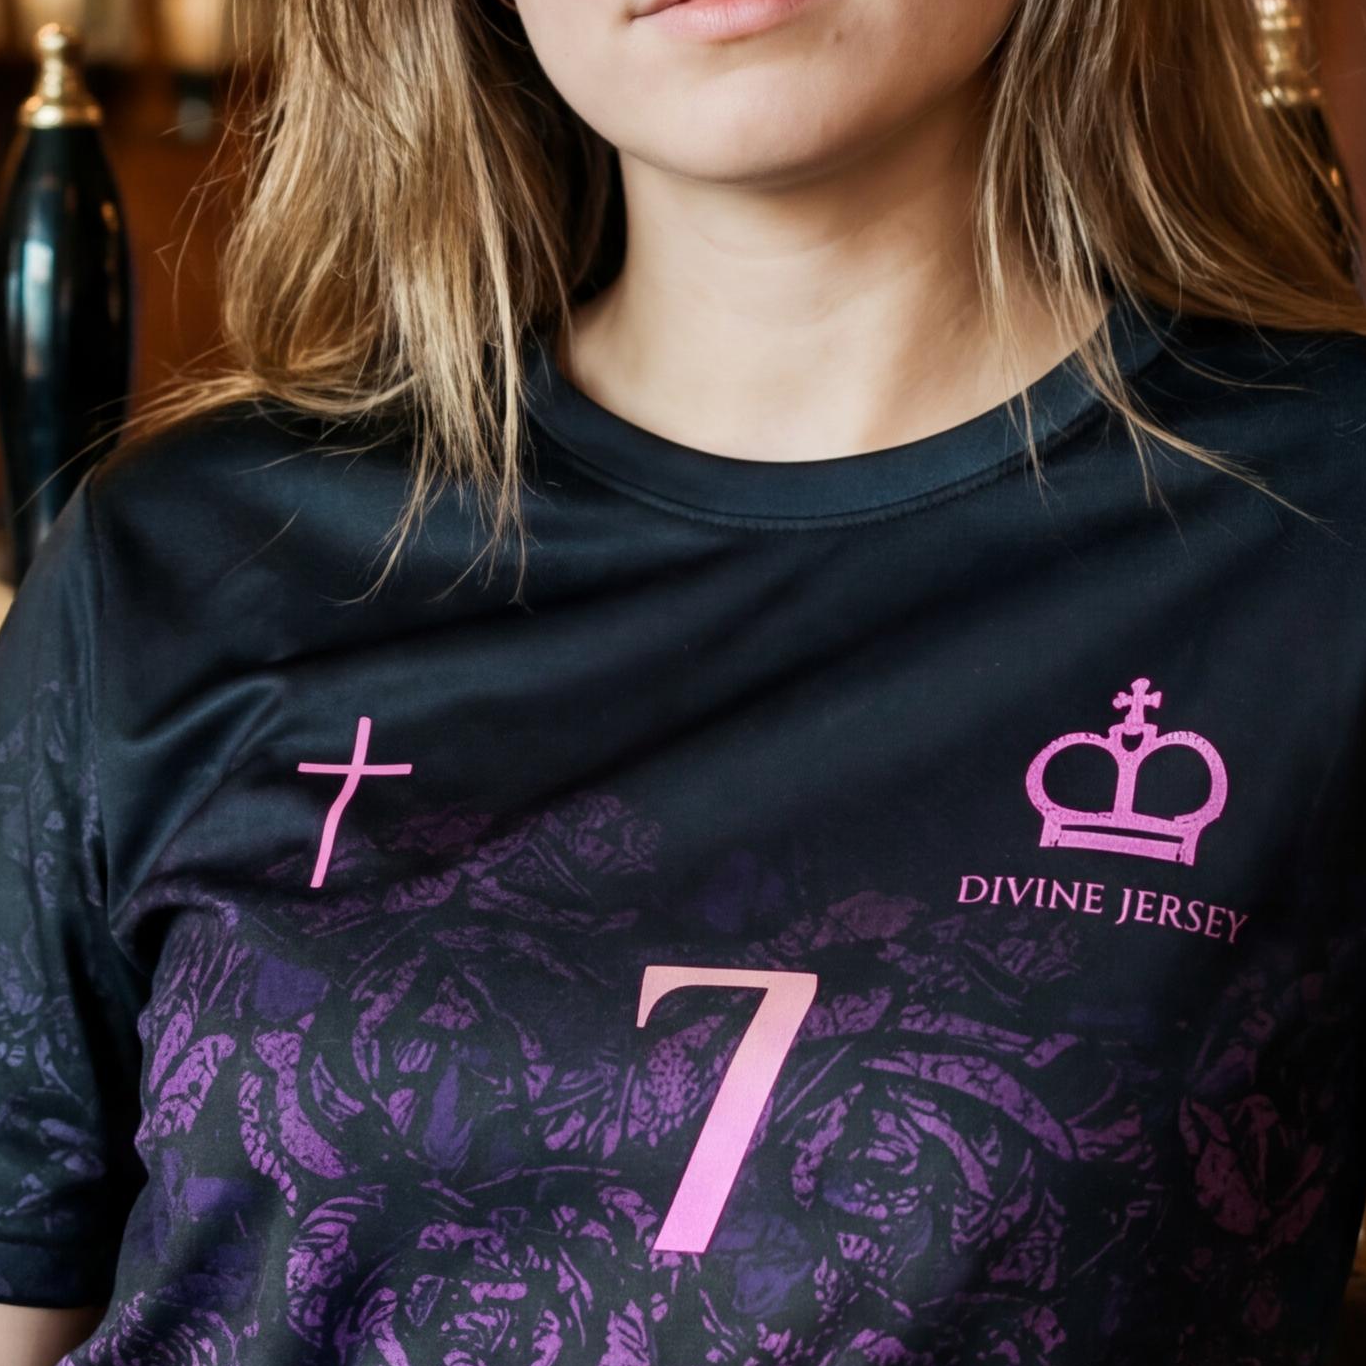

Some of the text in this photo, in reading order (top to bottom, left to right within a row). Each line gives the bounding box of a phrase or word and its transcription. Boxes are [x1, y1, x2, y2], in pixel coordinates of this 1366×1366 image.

[957, 875, 1249, 944] DIVINE JERSEY
[636, 964, 818, 1254] 7
